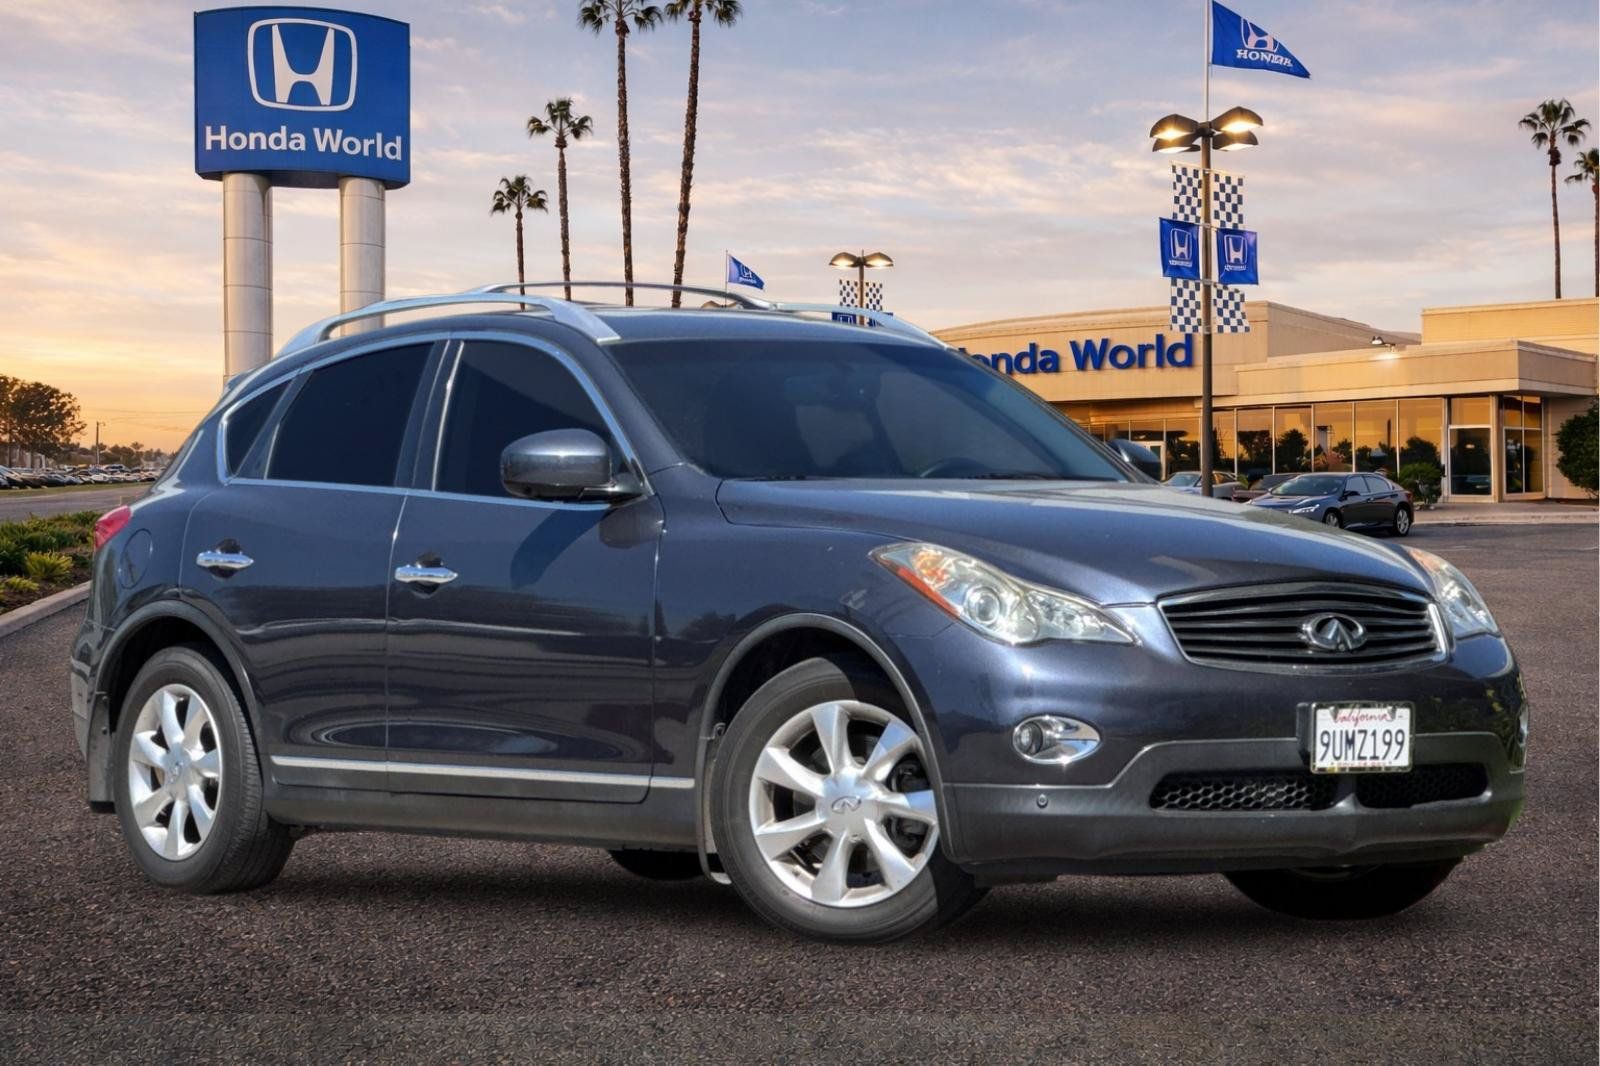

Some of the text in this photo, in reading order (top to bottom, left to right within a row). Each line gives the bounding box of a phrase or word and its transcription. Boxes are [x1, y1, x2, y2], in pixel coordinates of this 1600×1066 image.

[205, 125, 402, 161] Honda World
[1070, 333, 1193, 371] World
[1320, 729, 1405, 761] 9UMZ199
